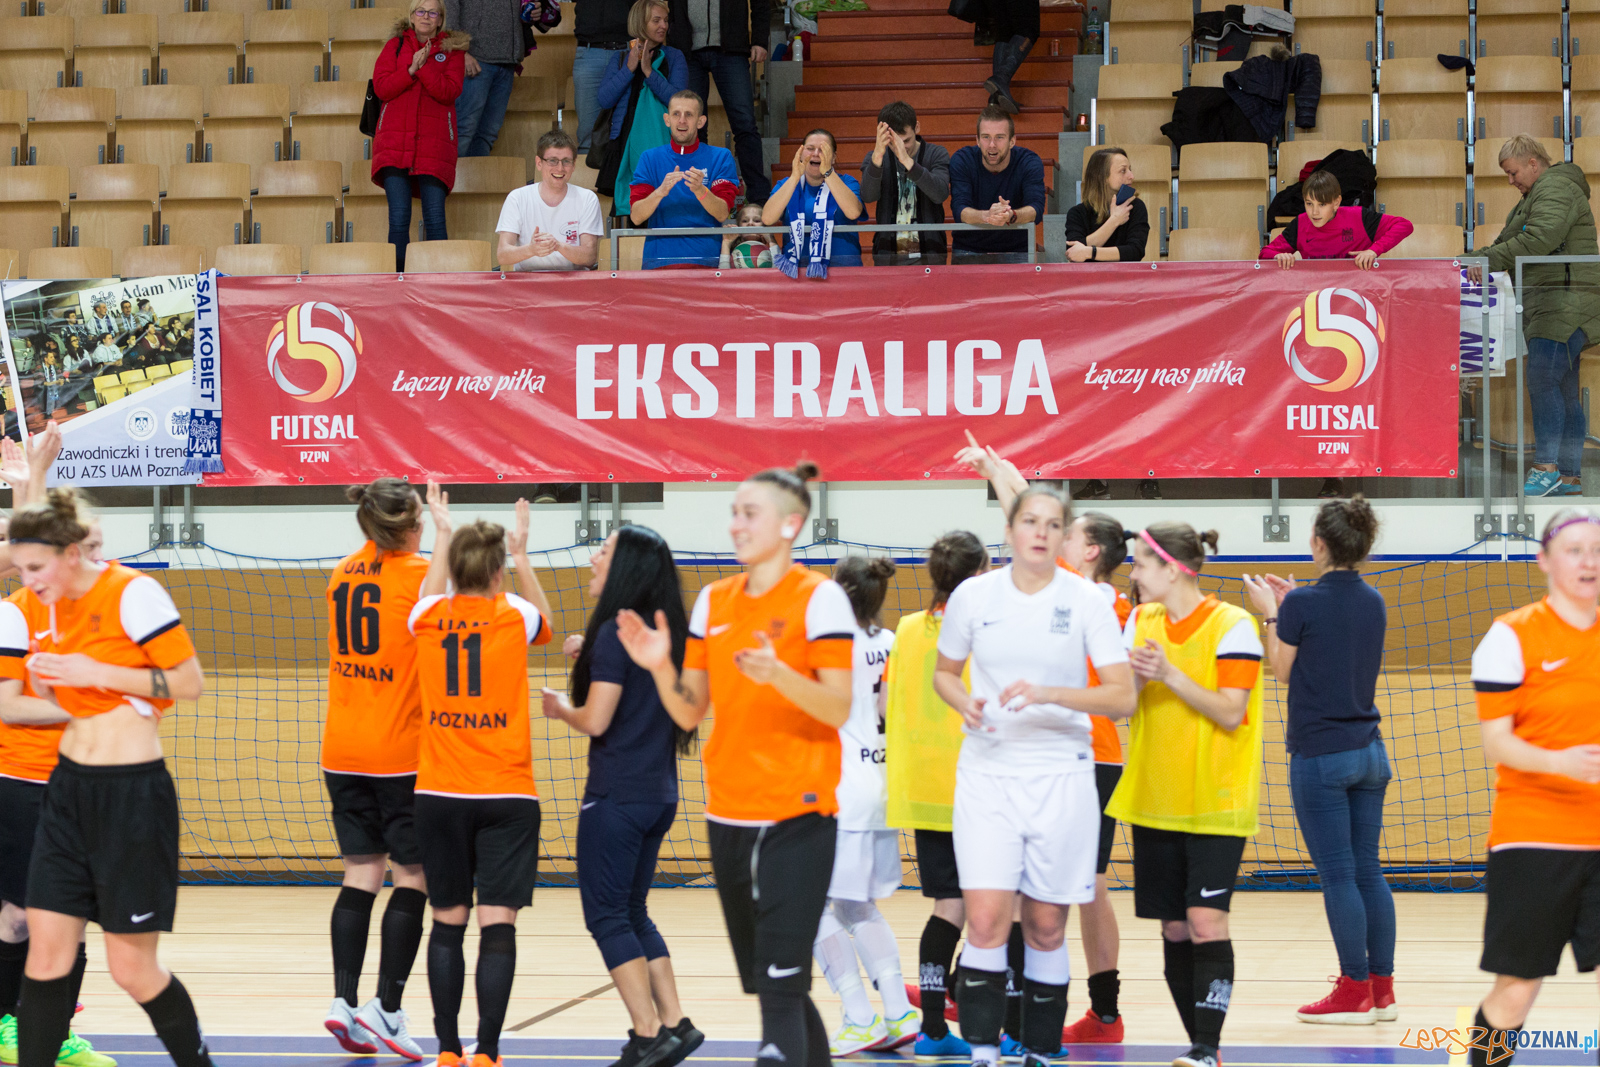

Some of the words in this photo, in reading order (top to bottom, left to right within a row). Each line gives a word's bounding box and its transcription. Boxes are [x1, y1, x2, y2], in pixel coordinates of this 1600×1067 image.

[121, 282, 164, 300] Adam
[199, 327, 215, 402] KOBIET
[1084, 361, 1149, 394] Łączy
[1151, 367, 1190, 387] nas
[1187, 360, 1246, 394] piłka
[391, 370, 453, 401] Łączy
[455, 375, 493, 394] nas
[489, 368, 546, 401] piłka
[575, 338, 1059, 421] EKSTRALIGA
[270, 414, 359, 440] FUTSAL
[1286, 404, 1380, 430] FUTSAL
[57, 445, 140, 461] Zawodniczki
[145, 445, 149, 458] i
[189, 438, 218, 453] UAM
[300, 450, 330, 463] PZPN
[1317, 441, 1350, 454] PZPN
[57, 466, 76, 480] KU
[80, 464, 107, 479] AZS
[111, 464, 143, 478] UAM
[344, 561, 383, 576] UAM
[332, 582, 381, 656] 16
[441, 632, 482, 697] 11
